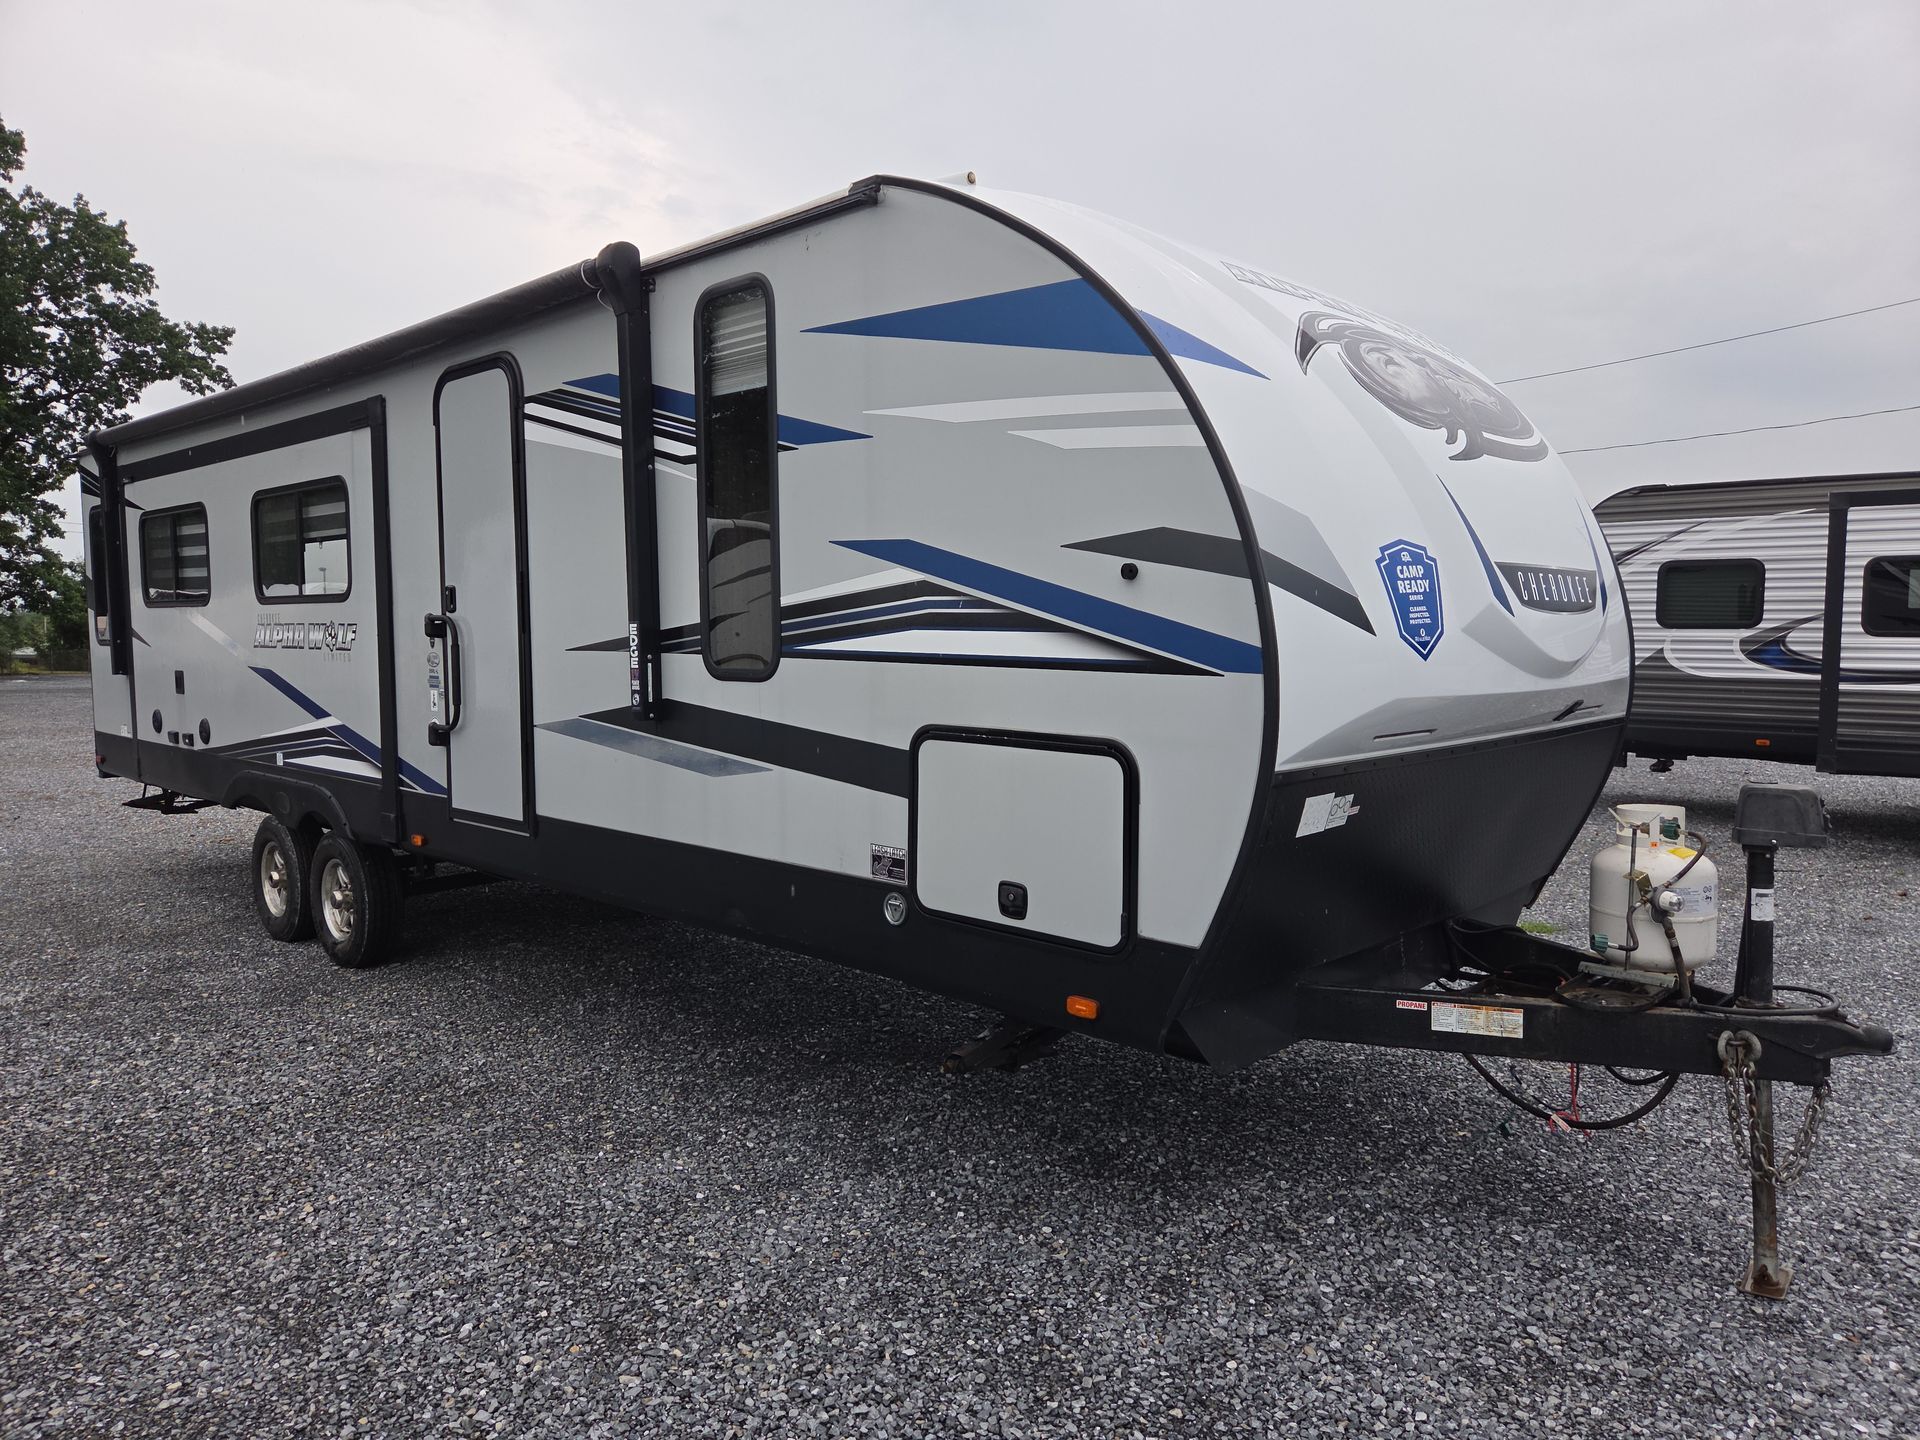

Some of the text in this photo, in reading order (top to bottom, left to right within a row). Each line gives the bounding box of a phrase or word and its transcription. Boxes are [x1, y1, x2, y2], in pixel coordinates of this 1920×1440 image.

[1396, 565, 1424, 579] CAMP
[1397, 579, 1430, 594] READY
[1517, 571, 1592, 603] CHEROKEE
[253, 622, 305, 650] ALPHA
[629, 623, 640, 669] EDGE
[1397, 1000, 1428, 1010] PROPANE
